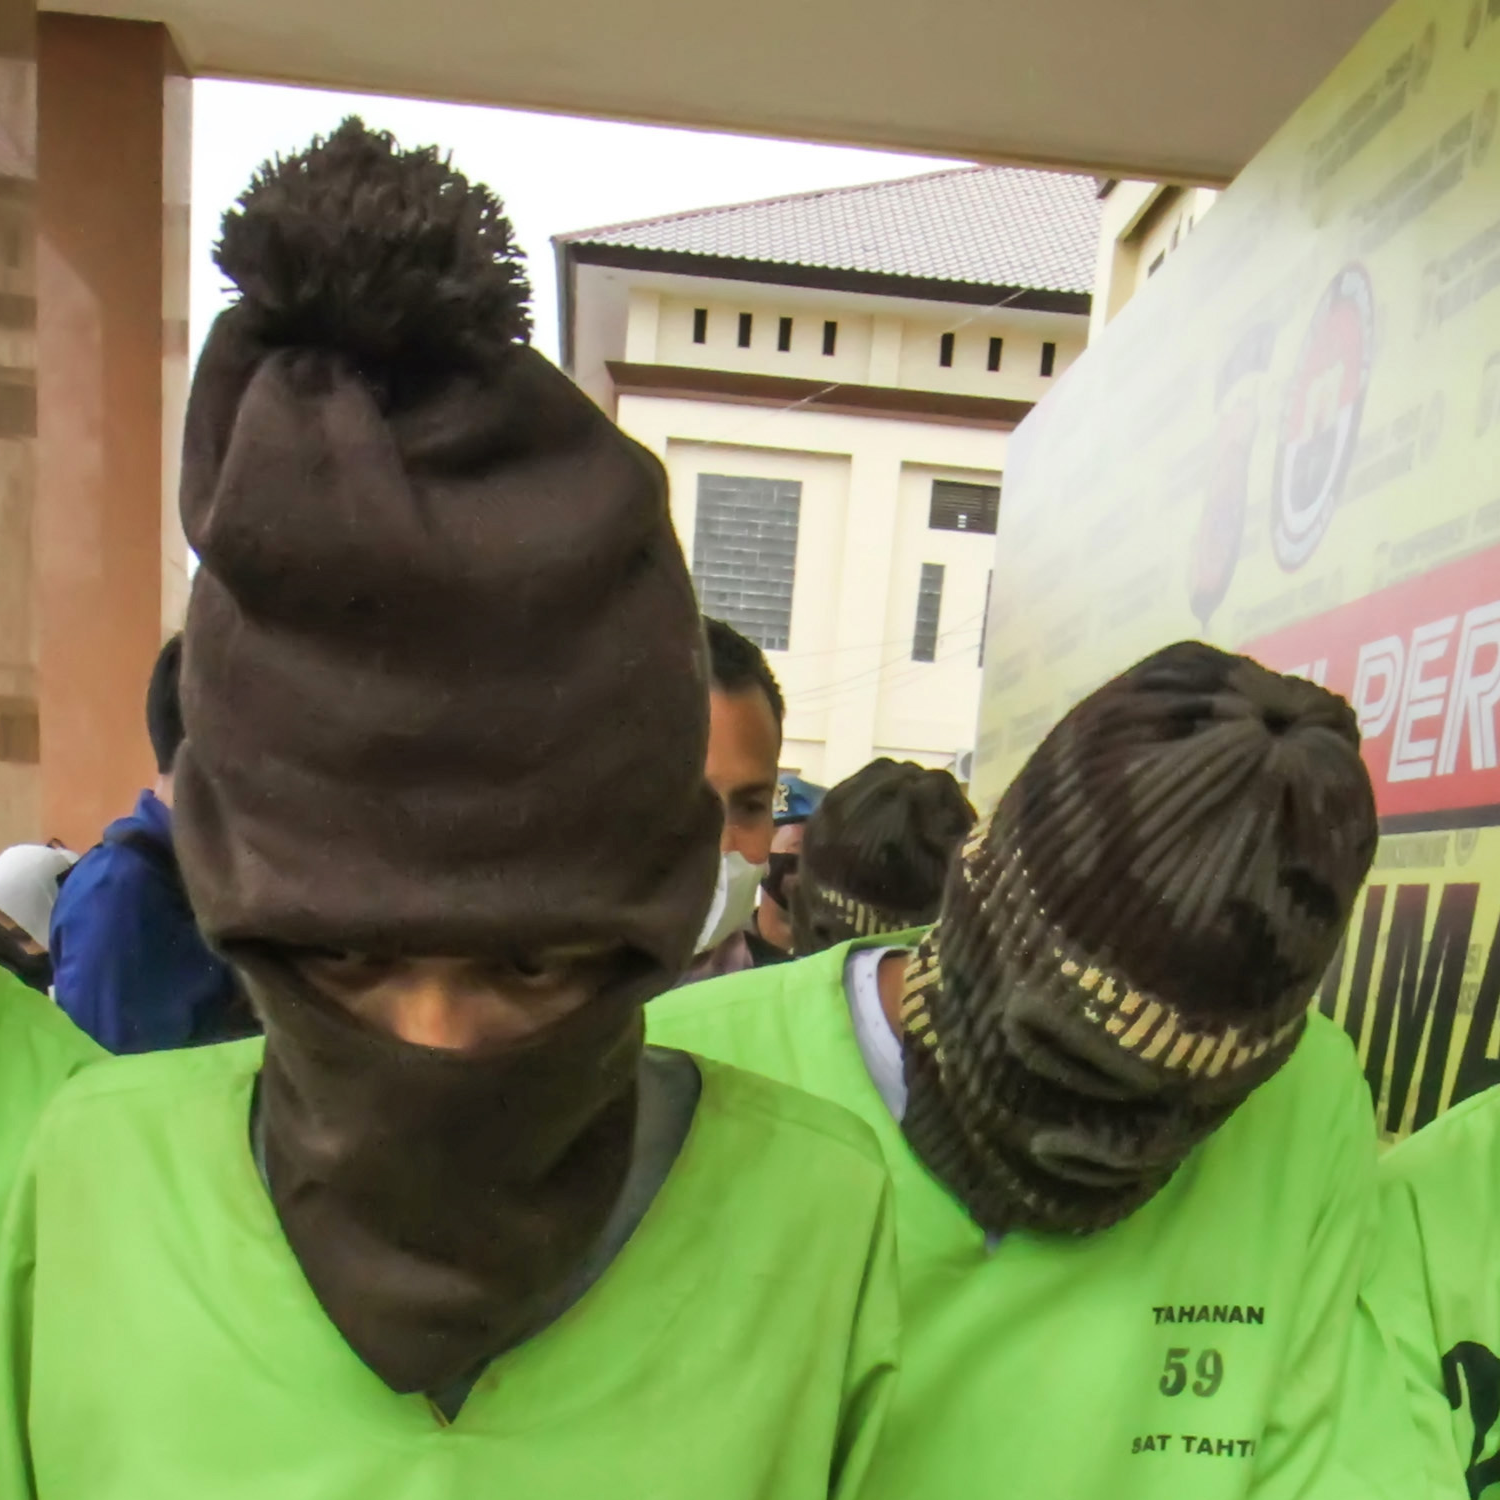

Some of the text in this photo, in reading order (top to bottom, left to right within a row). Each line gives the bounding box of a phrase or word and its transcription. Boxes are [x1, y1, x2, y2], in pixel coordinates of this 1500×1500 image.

[1152, 1304, 1265, 1325] TAHANAN
[1158, 1347, 1224, 1398] 59
[1131, 1434, 1256, 1458] SAT TAHTI
